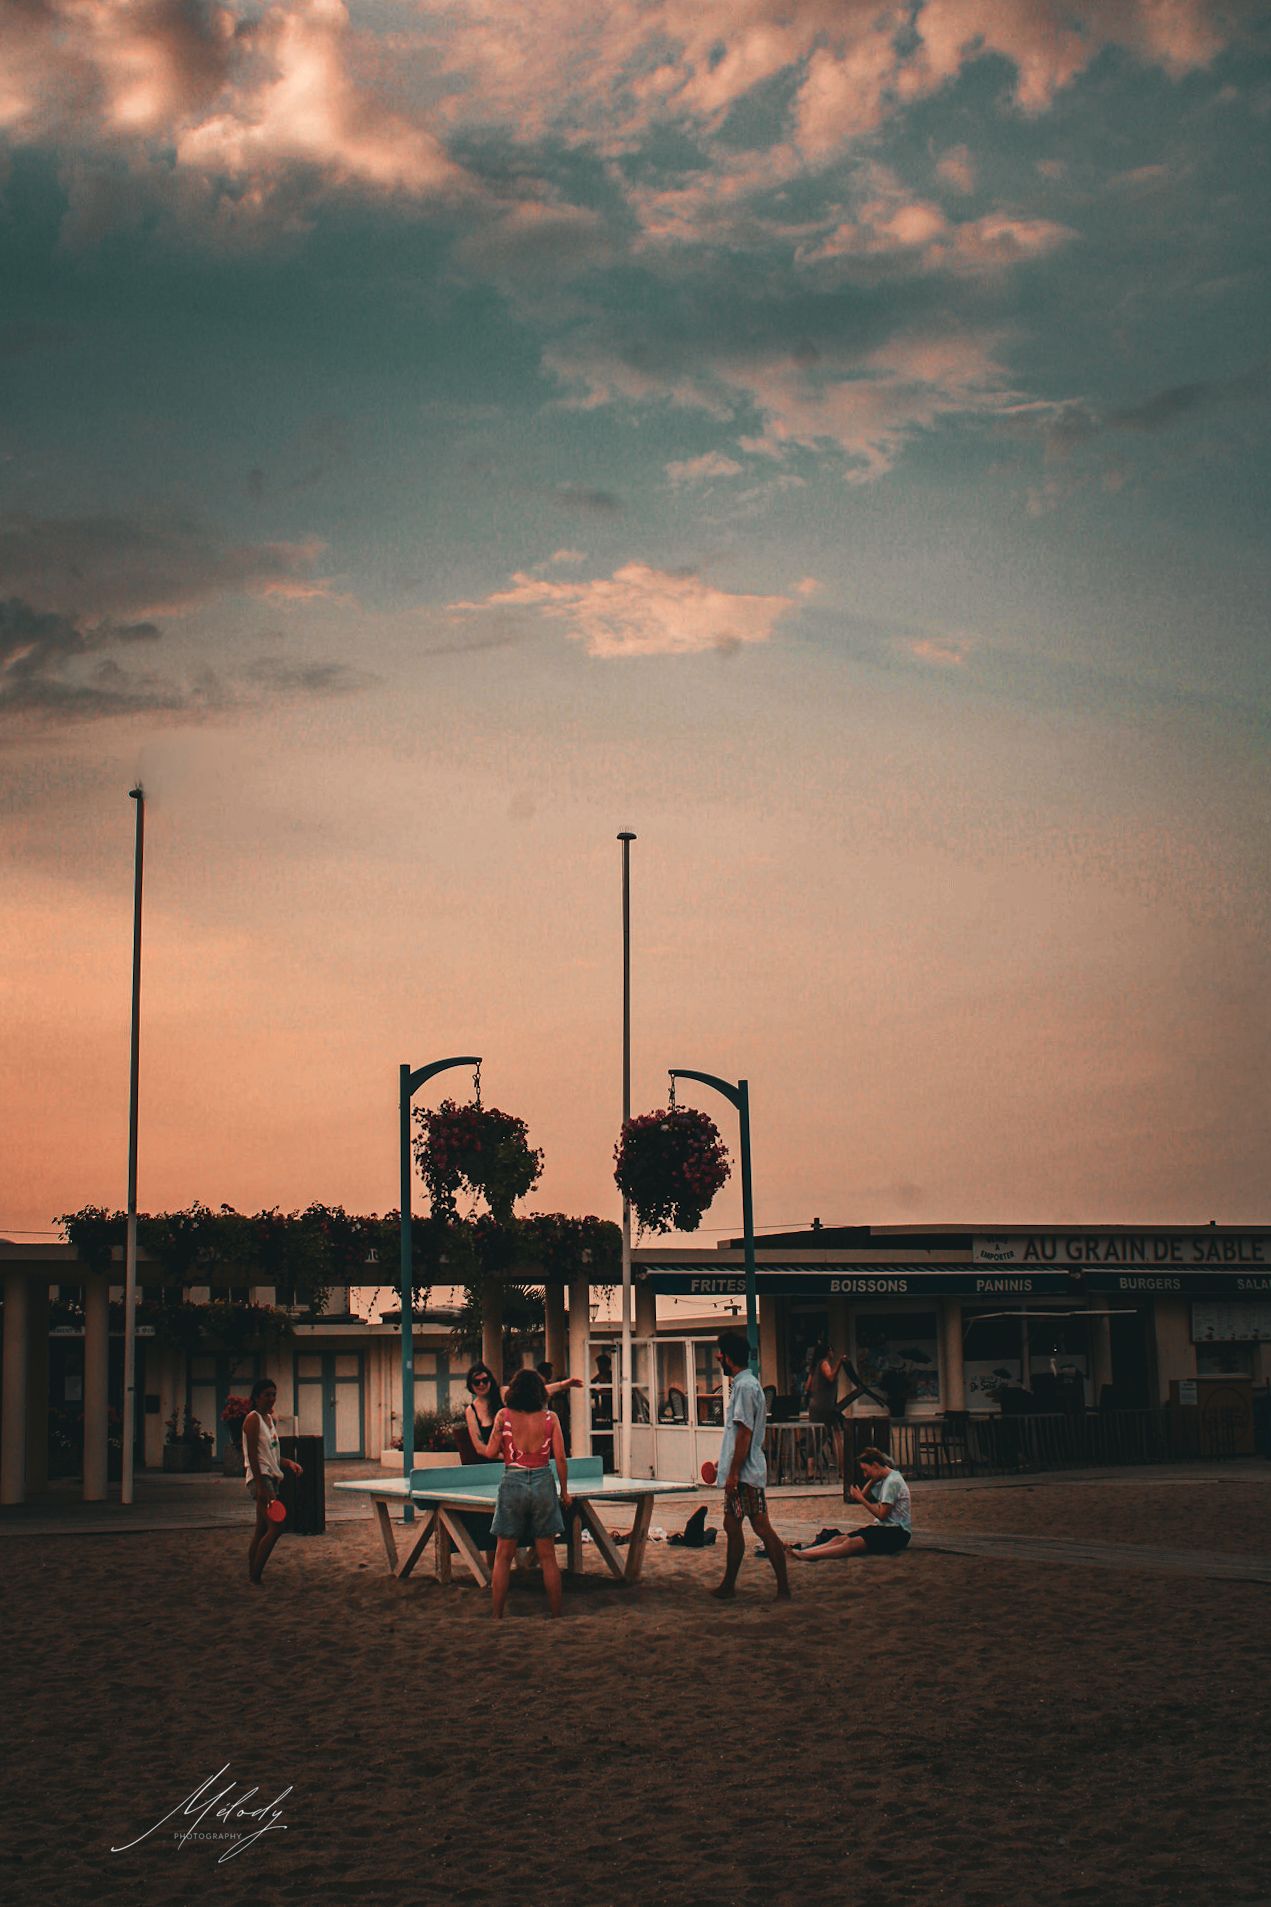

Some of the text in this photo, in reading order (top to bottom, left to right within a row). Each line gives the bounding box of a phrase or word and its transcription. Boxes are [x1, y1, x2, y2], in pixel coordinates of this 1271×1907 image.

[1024, 1236, 1264, 1262] AU GRAIN DE SABLE
[691, 1279, 747, 1292] FRITES
[830, 1279, 908, 1292] BOISSONS
[976, 1279, 1033, 1292] PANINIS
[1119, 1277, 1181, 1290] BURGERS
[1236, 1278, 1271, 1290] SALA
